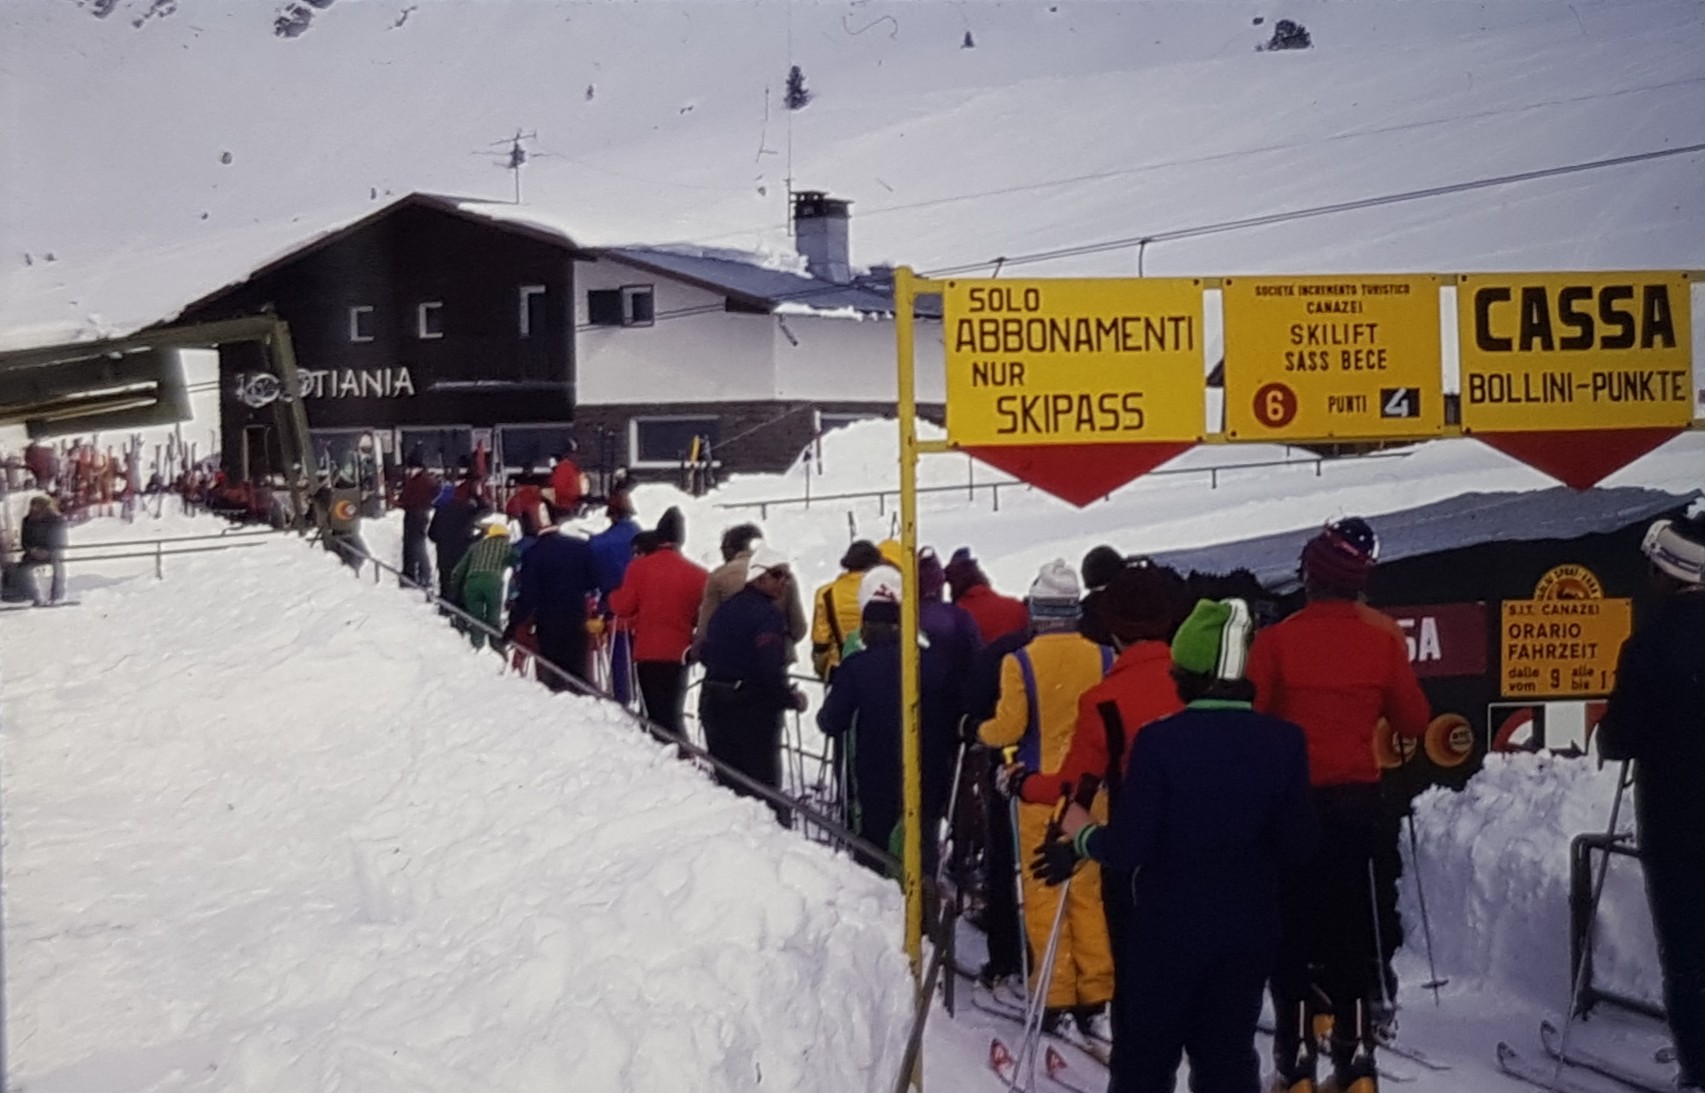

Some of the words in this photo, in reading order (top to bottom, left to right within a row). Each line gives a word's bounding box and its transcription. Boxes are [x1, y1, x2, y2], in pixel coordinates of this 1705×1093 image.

[968, 287, 1040, 313] SOLO
[1361, 283, 1410, 296] TURISTICO
[1306, 301, 1364, 315] CANAZEI
[1474, 284, 1677, 352] CASSA
[955, 315, 1194, 353] ABBONAMENTI
[1290, 323, 1379, 346] SKILIFT
[1284, 351, 1330, 372] SASS
[1340, 349, 1388, 371] BECE
[971, 361, 1025, 387] NUR
[1468, 370, 1687, 404] BOLLINI-PUNKTE
[996, 392, 1145, 434] SKIPASS
[1266, 389, 1285, 421] 6
[1328, 394, 1368, 414] PUNTI
[1384, 387, 1409, 418] 4
[1541, 603, 1600, 616] CANAZEI
[1508, 622, 1582, 639] ORARIO
[1508, 642, 1598, 660] FAHRZEIT
[1508, 665, 1540, 679] dalle
[1549, 668, 1560, 689] 9
[1571, 664, 1595, 677] alle
[1508, 681, 1537, 692] vom
[1570, 679, 1591, 690] bis
